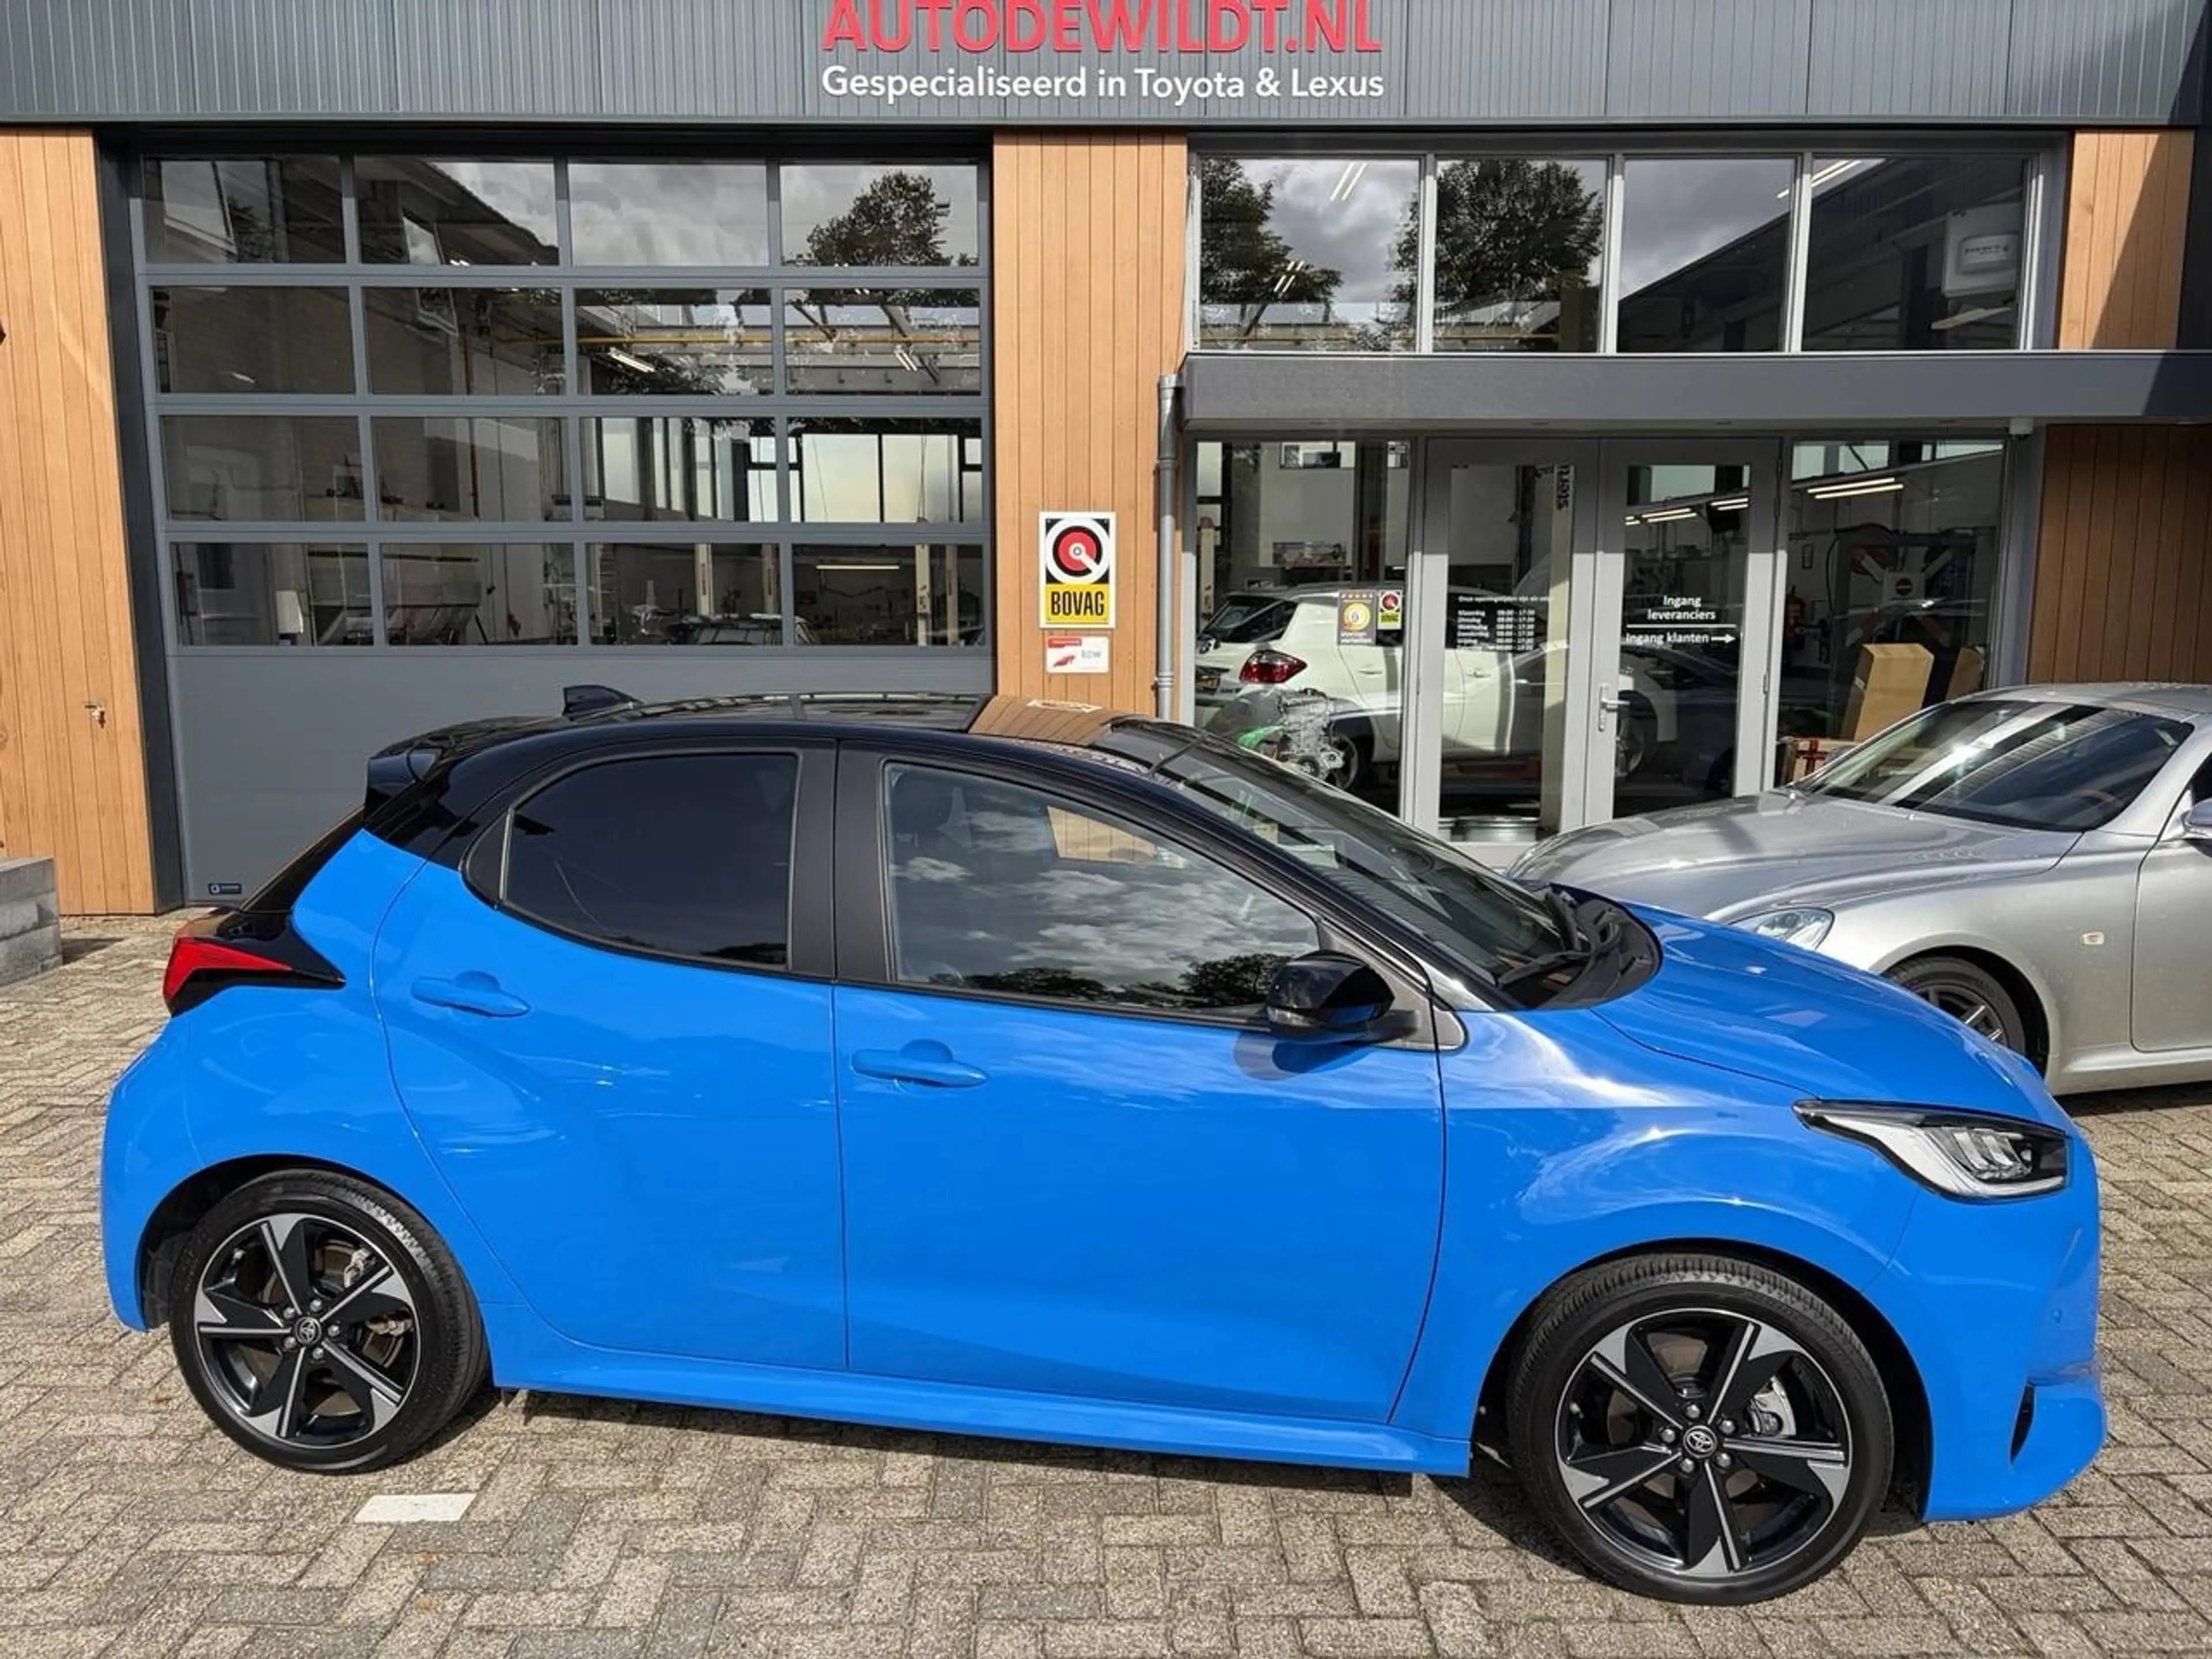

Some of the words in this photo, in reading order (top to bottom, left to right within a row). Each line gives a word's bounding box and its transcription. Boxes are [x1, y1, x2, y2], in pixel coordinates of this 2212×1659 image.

[823, 0, 1381, 53] AUTODEWILDT.NL
[823, 65, 1086, 104] Gespecialiseerd
[1098, 69, 1126, 96] in
[1134, 69, 1244, 106] Toyota
[1256, 67, 1280, 97] &
[1292, 69, 1384, 97] Lexus
[1051, 591, 1104, 616] BOVAG
[1663, 596, 1701, 608] Ingang
[1647, 609, 1716, 620] leveranciers
[1625, 633, 1664, 645] Ingang
[1666, 632, 1709, 643] klanten
